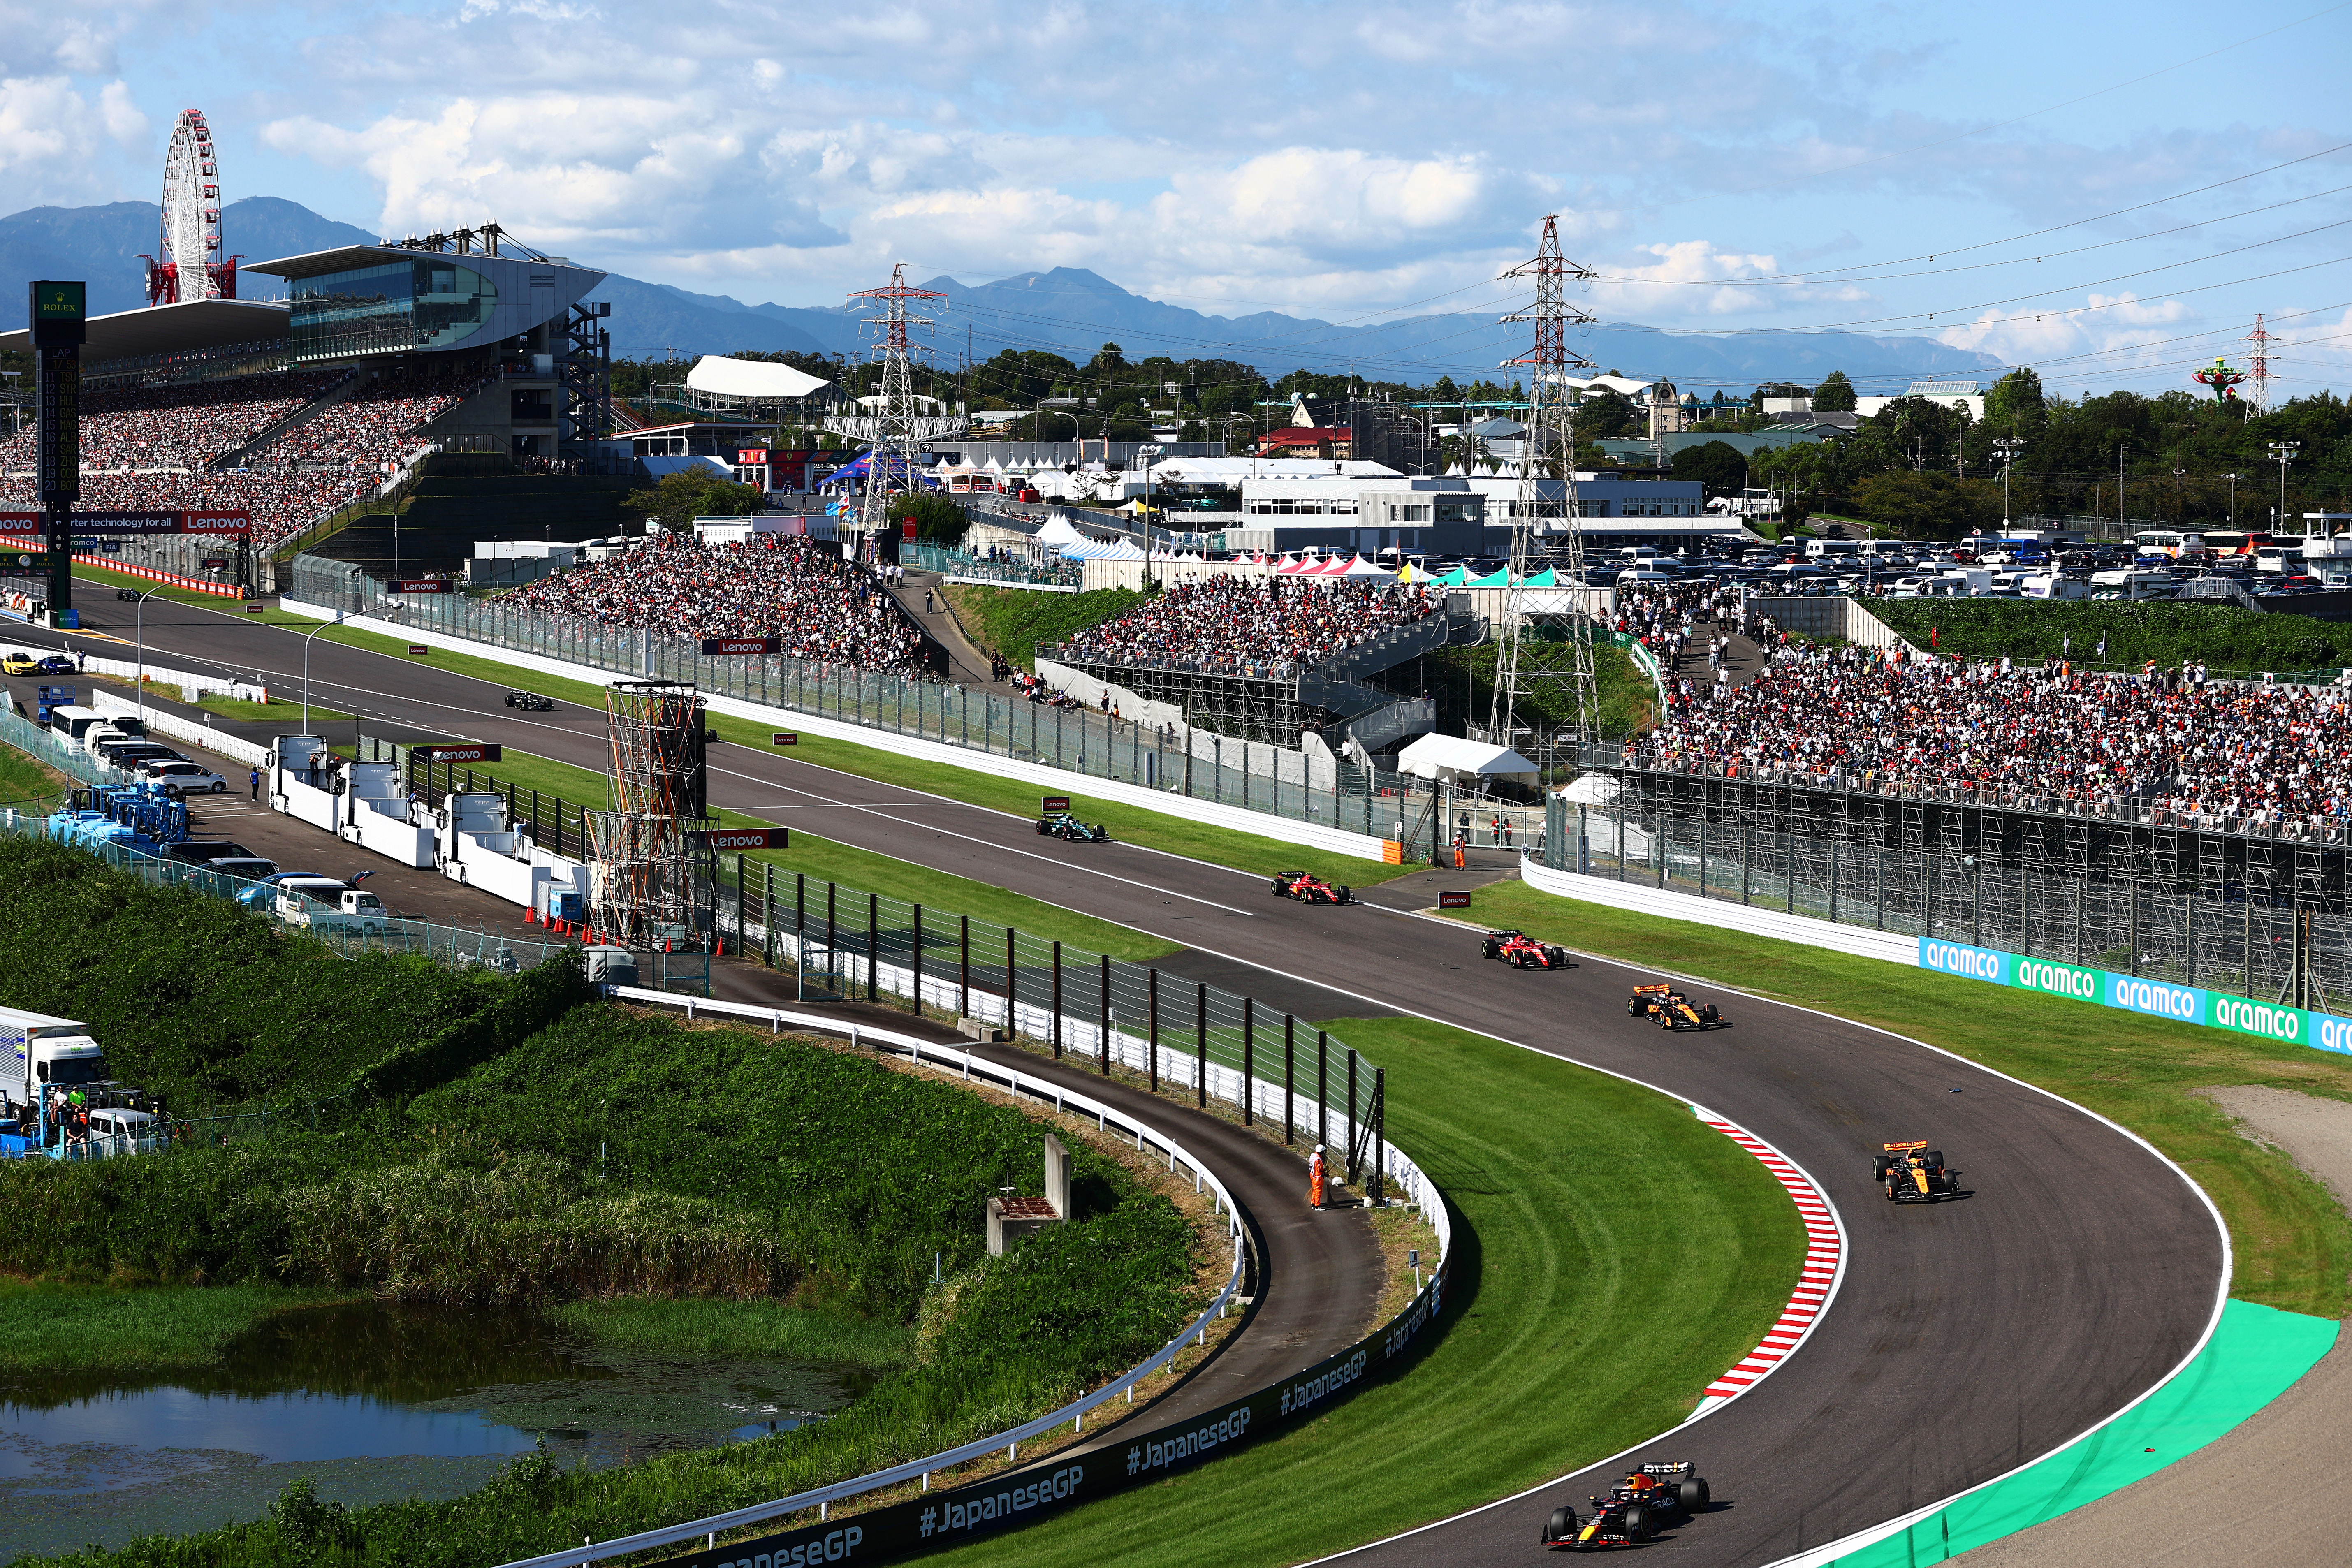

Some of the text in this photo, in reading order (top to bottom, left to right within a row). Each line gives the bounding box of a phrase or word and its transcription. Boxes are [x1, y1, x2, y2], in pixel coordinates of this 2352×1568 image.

[52, 349, 70, 357] LAP
[67, 360, 76, 369] 53
[46, 372, 76, 382] 11 TSU
[46, 383, 76, 394] 12 STR
[46, 396, 76, 406] 13 HUL
[46, 408, 76, 418] 14 GAS
[46, 419, 76, 430] 15 MAG
[46, 432, 76, 442] 16 ALB
[46, 444, 76, 454] 17 SAR
[46, 456, 76, 466] 18 ZHO
[951, 453, 956, 463] 3
[46, 468, 76, 479] 19 OCO
[45, 480, 77, 491] 20 BOT
[1291, 484, 1351, 497] Safety for Everyone
[0, 519, 33, 530] ovo
[91, 518, 143, 528] technology
[146, 518, 159, 526] for
[161, 518, 171, 526] all
[188, 516, 246, 529] Lenovo
[404, 582, 438, 591] Lenovo
[722, 642, 762, 653] Lenovo
[1927, 943, 1998, 979] aramco
[2019, 961, 2095, 998] aramco
[2116, 980, 2194, 1018] aramco
[2216, 998, 2298, 1040] aramco
[1386, 1293, 1429, 1358] #JapaneseGP
[1281, 1350, 1367, 1416] #JapaneseGP
[1127, 1406, 1251, 1476] #JapaneseGP
[919, 1465, 1083, 1538] #JapaneseGP
[1650, 1497, 1675, 1510] ORACLE
